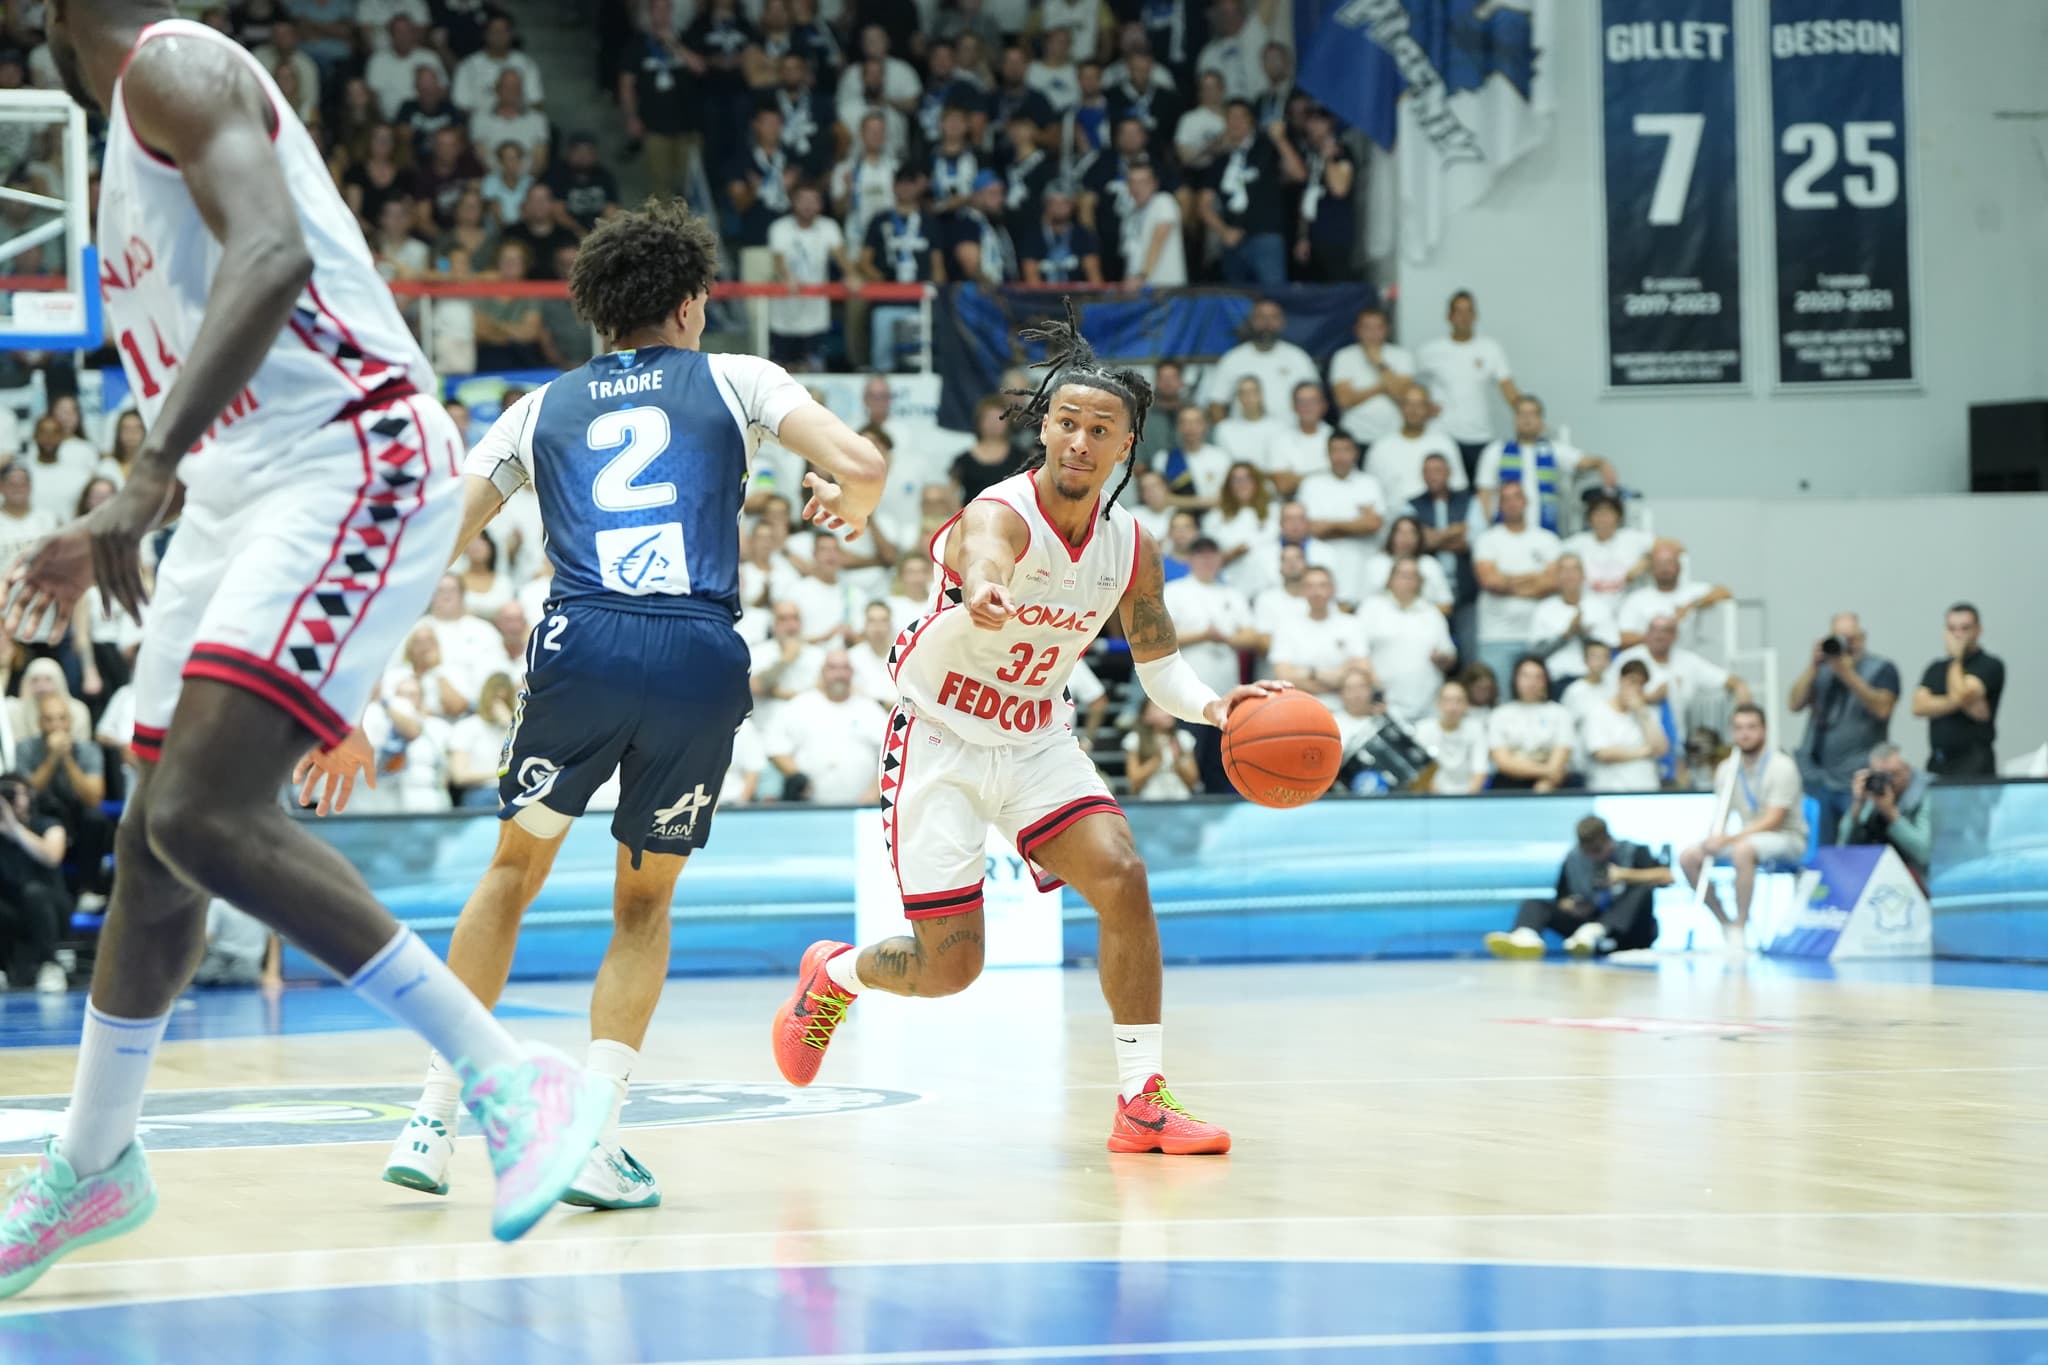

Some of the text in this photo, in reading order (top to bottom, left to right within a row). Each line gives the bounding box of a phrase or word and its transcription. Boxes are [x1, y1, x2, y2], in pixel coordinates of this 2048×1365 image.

[1606, 20, 1729, 62] GILLET
[1772, 19, 1901, 59] BESSON
[1632, 113, 1706, 226] 7
[1781, 120, 1899, 210] 25
[587, 369, 664, 400] TRAORE
[586, 405, 678, 512] 2
[543, 615, 569, 651] 2
[1009, 603, 1097, 633] ONAC
[996, 641, 1060, 687] 32
